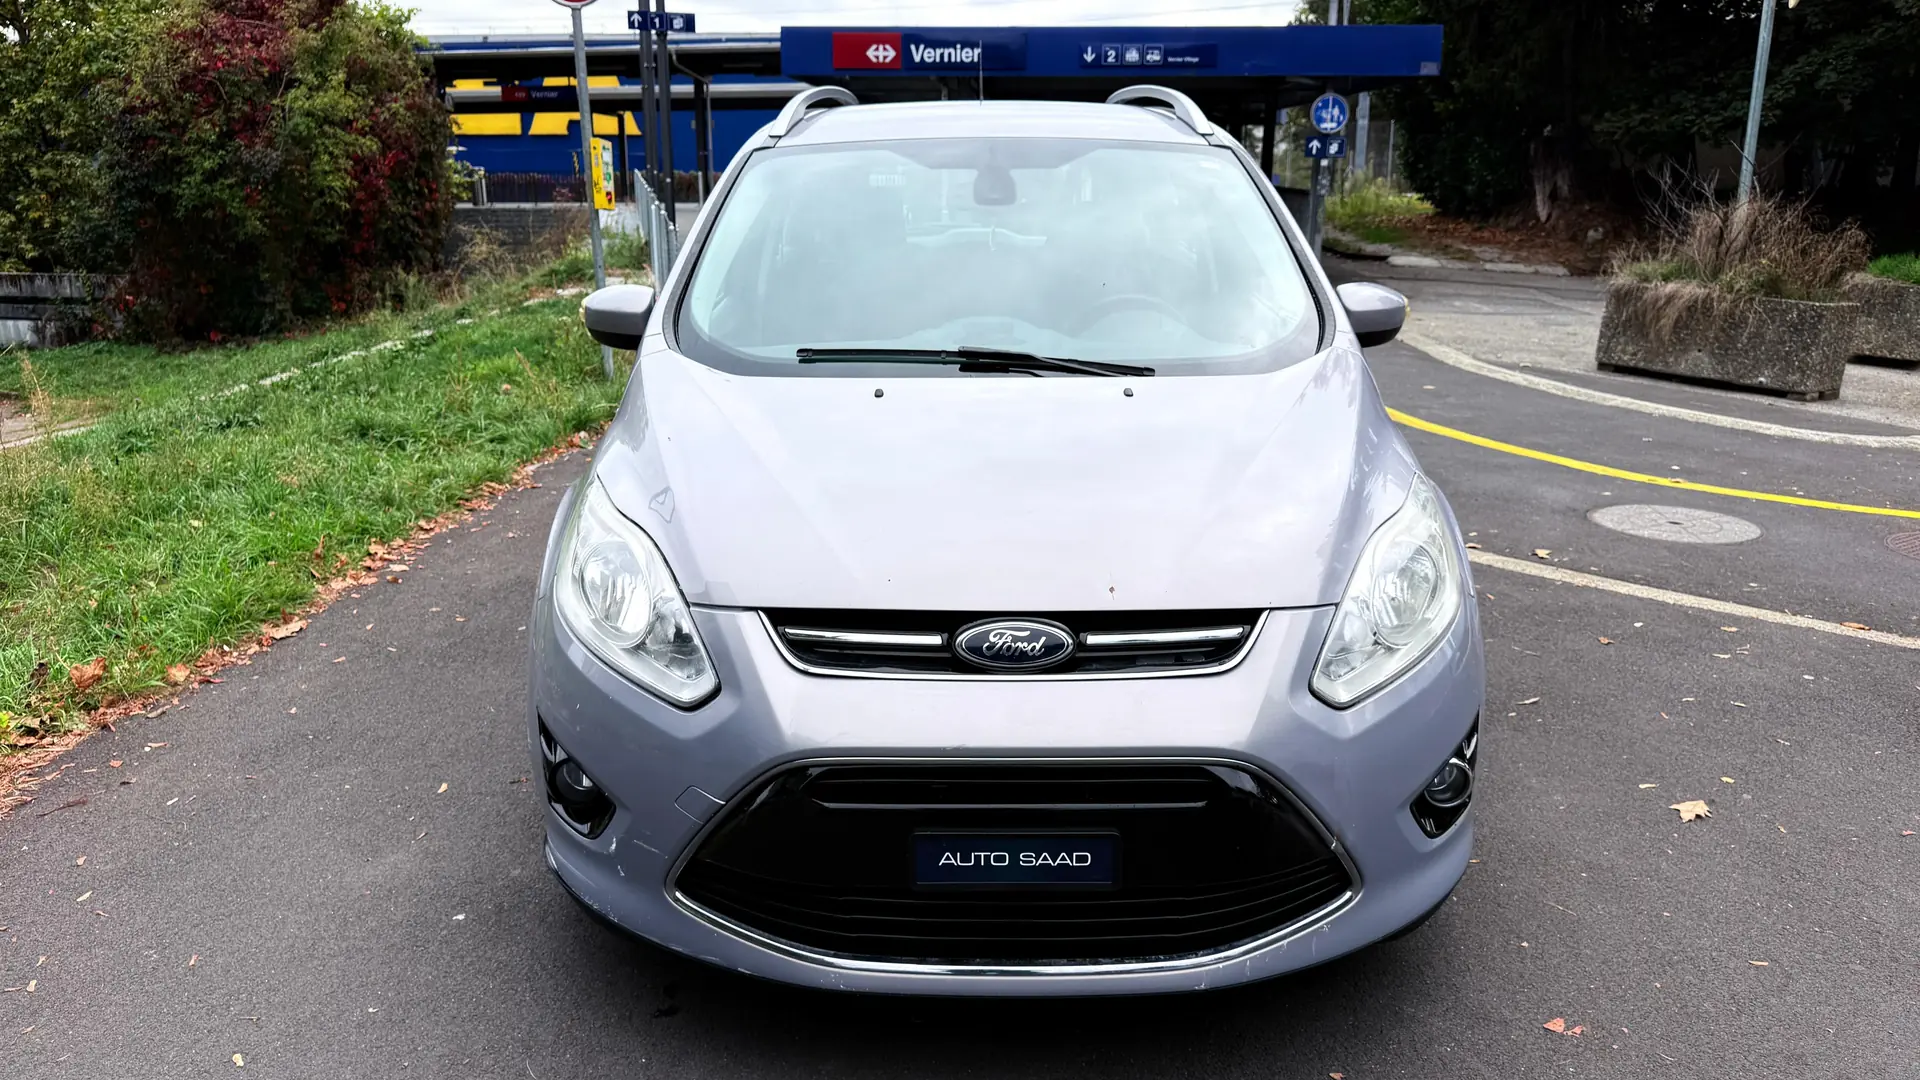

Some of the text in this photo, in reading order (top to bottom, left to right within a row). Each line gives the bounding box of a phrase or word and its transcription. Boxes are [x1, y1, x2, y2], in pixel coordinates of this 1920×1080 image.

[654, 16, 660, 29] 1
[910, 43, 982, 63] Vernier
[1106, 50, 1116, 63] 2
[530, 90, 559, 99] Vernier
[982, 629, 1047, 657] Ford
[938, 852, 1092, 867] AUTO SAAD
